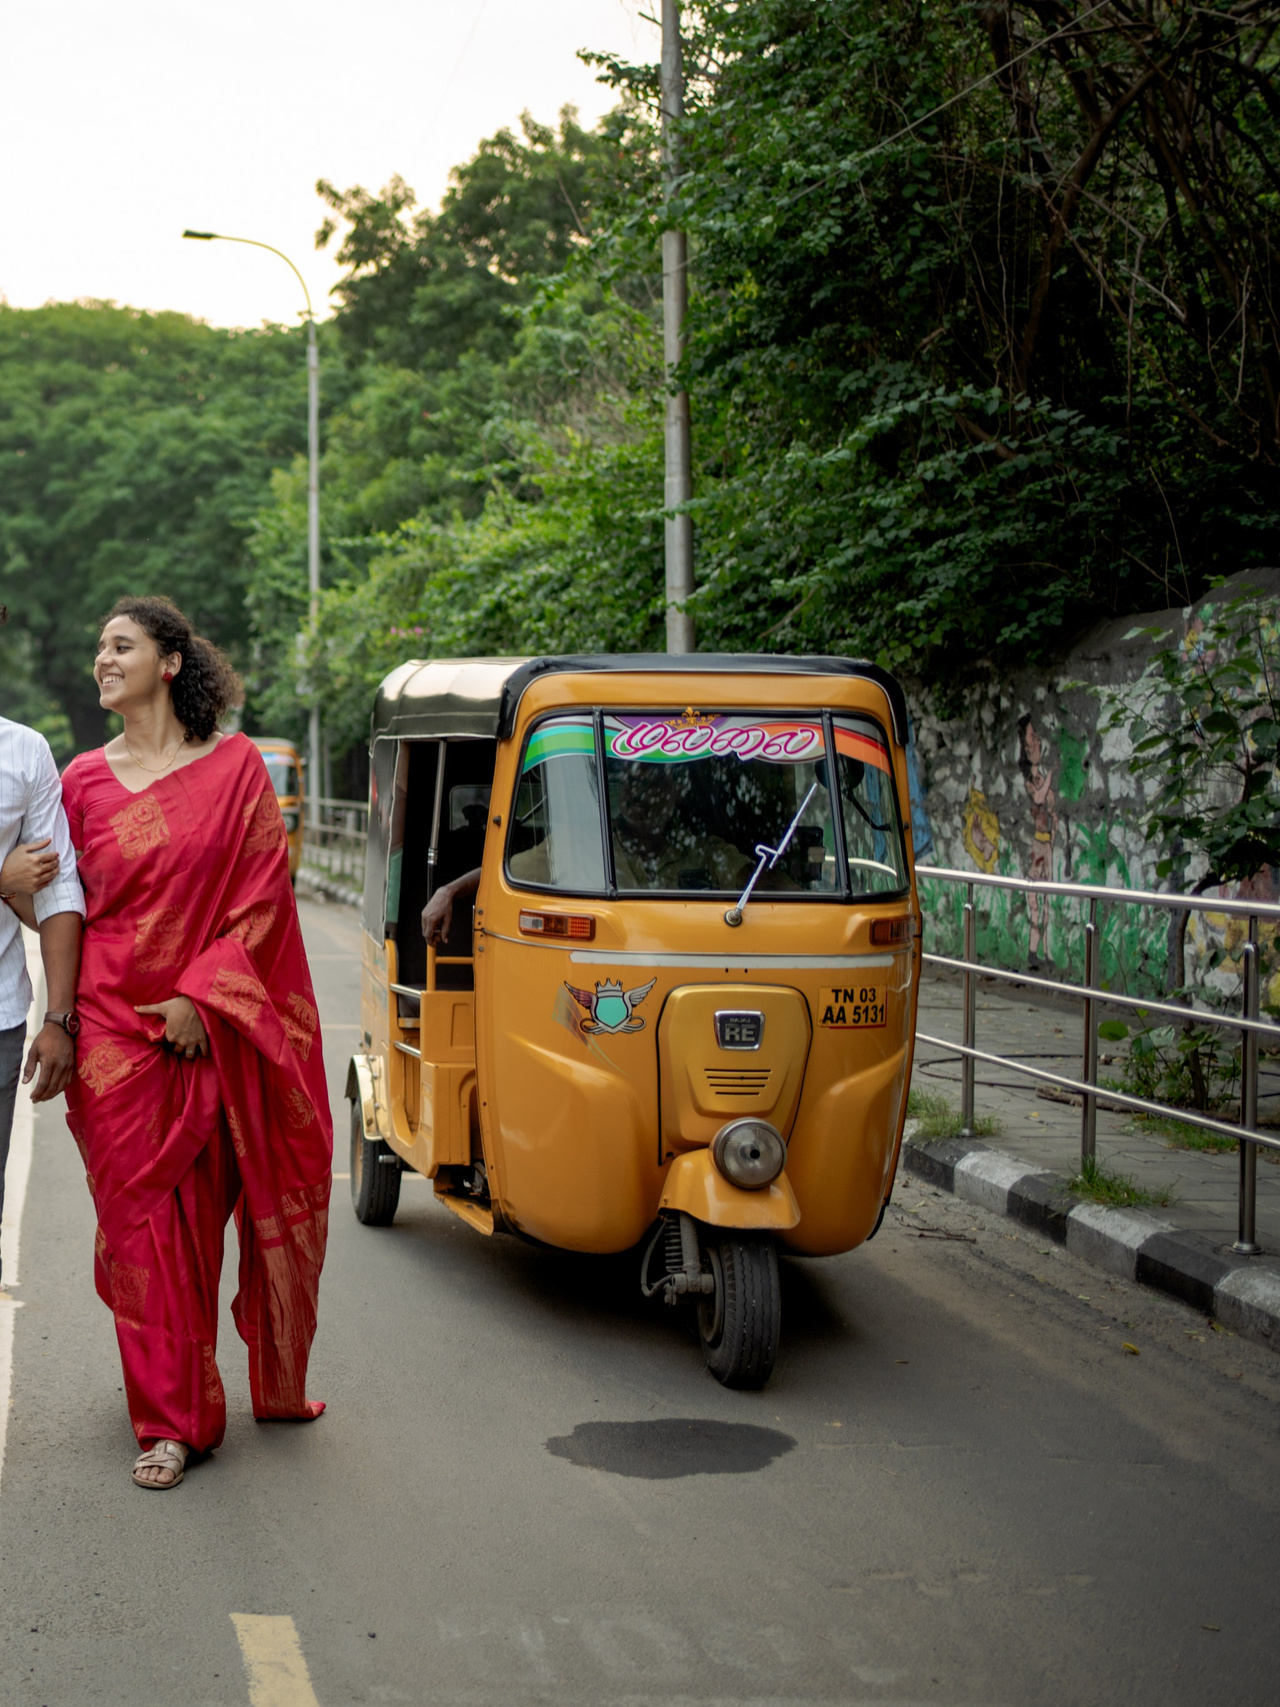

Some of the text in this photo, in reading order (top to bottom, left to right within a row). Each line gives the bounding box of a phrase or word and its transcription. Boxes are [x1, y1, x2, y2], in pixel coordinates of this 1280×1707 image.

[831, 988, 876, 1003] TN 03
[822, 1004, 884, 1023] AA 5131
[724, 1023, 756, 1041] RE
